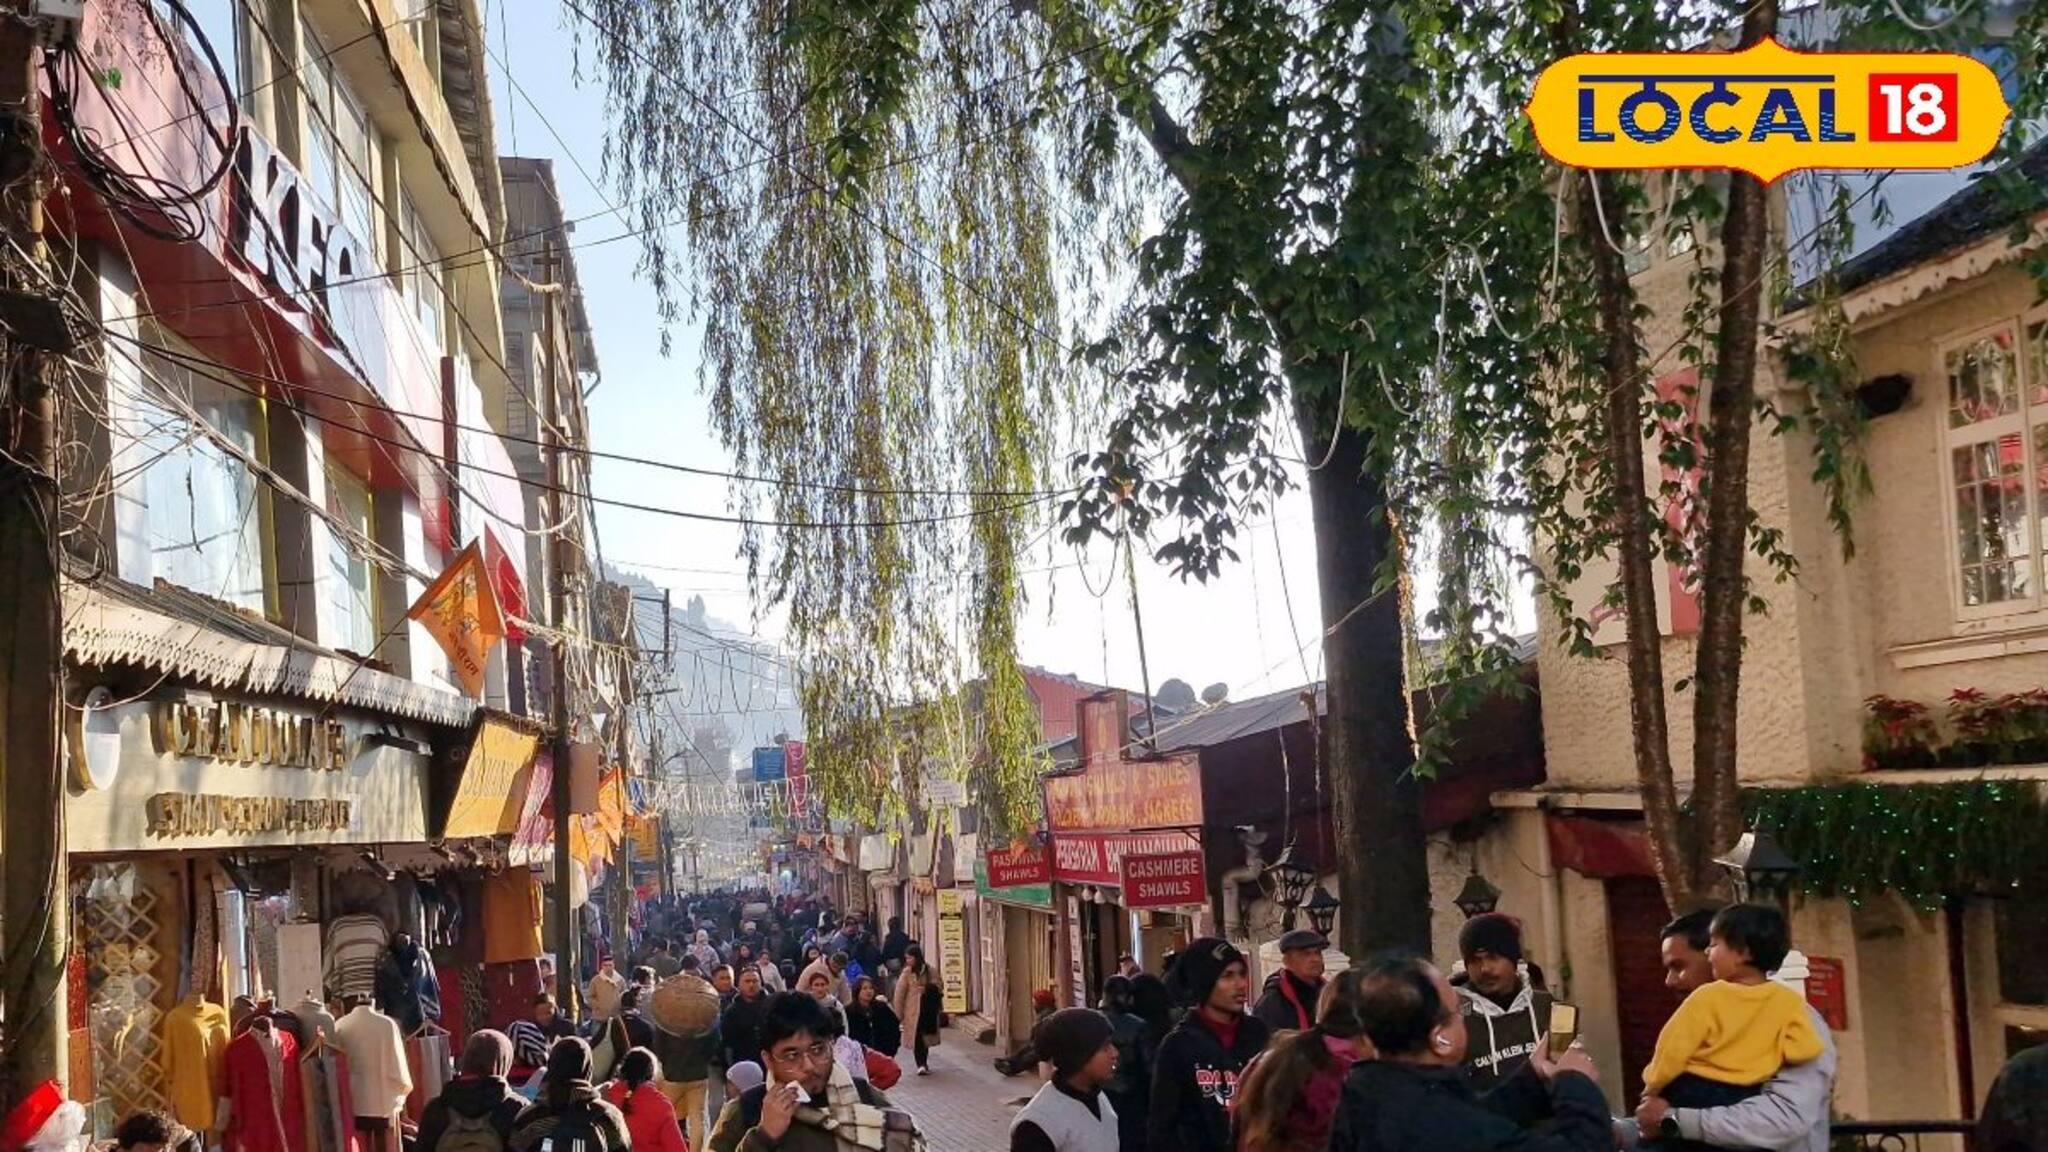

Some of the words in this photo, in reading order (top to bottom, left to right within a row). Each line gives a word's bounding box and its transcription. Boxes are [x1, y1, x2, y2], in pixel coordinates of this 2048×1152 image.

[224, 127, 360, 345] KFC
[999, 867, 1040, 881] SHAWLS
[1128, 857, 1199, 879] CASHMERE
[1138, 880, 1192, 899] SHAWLS
